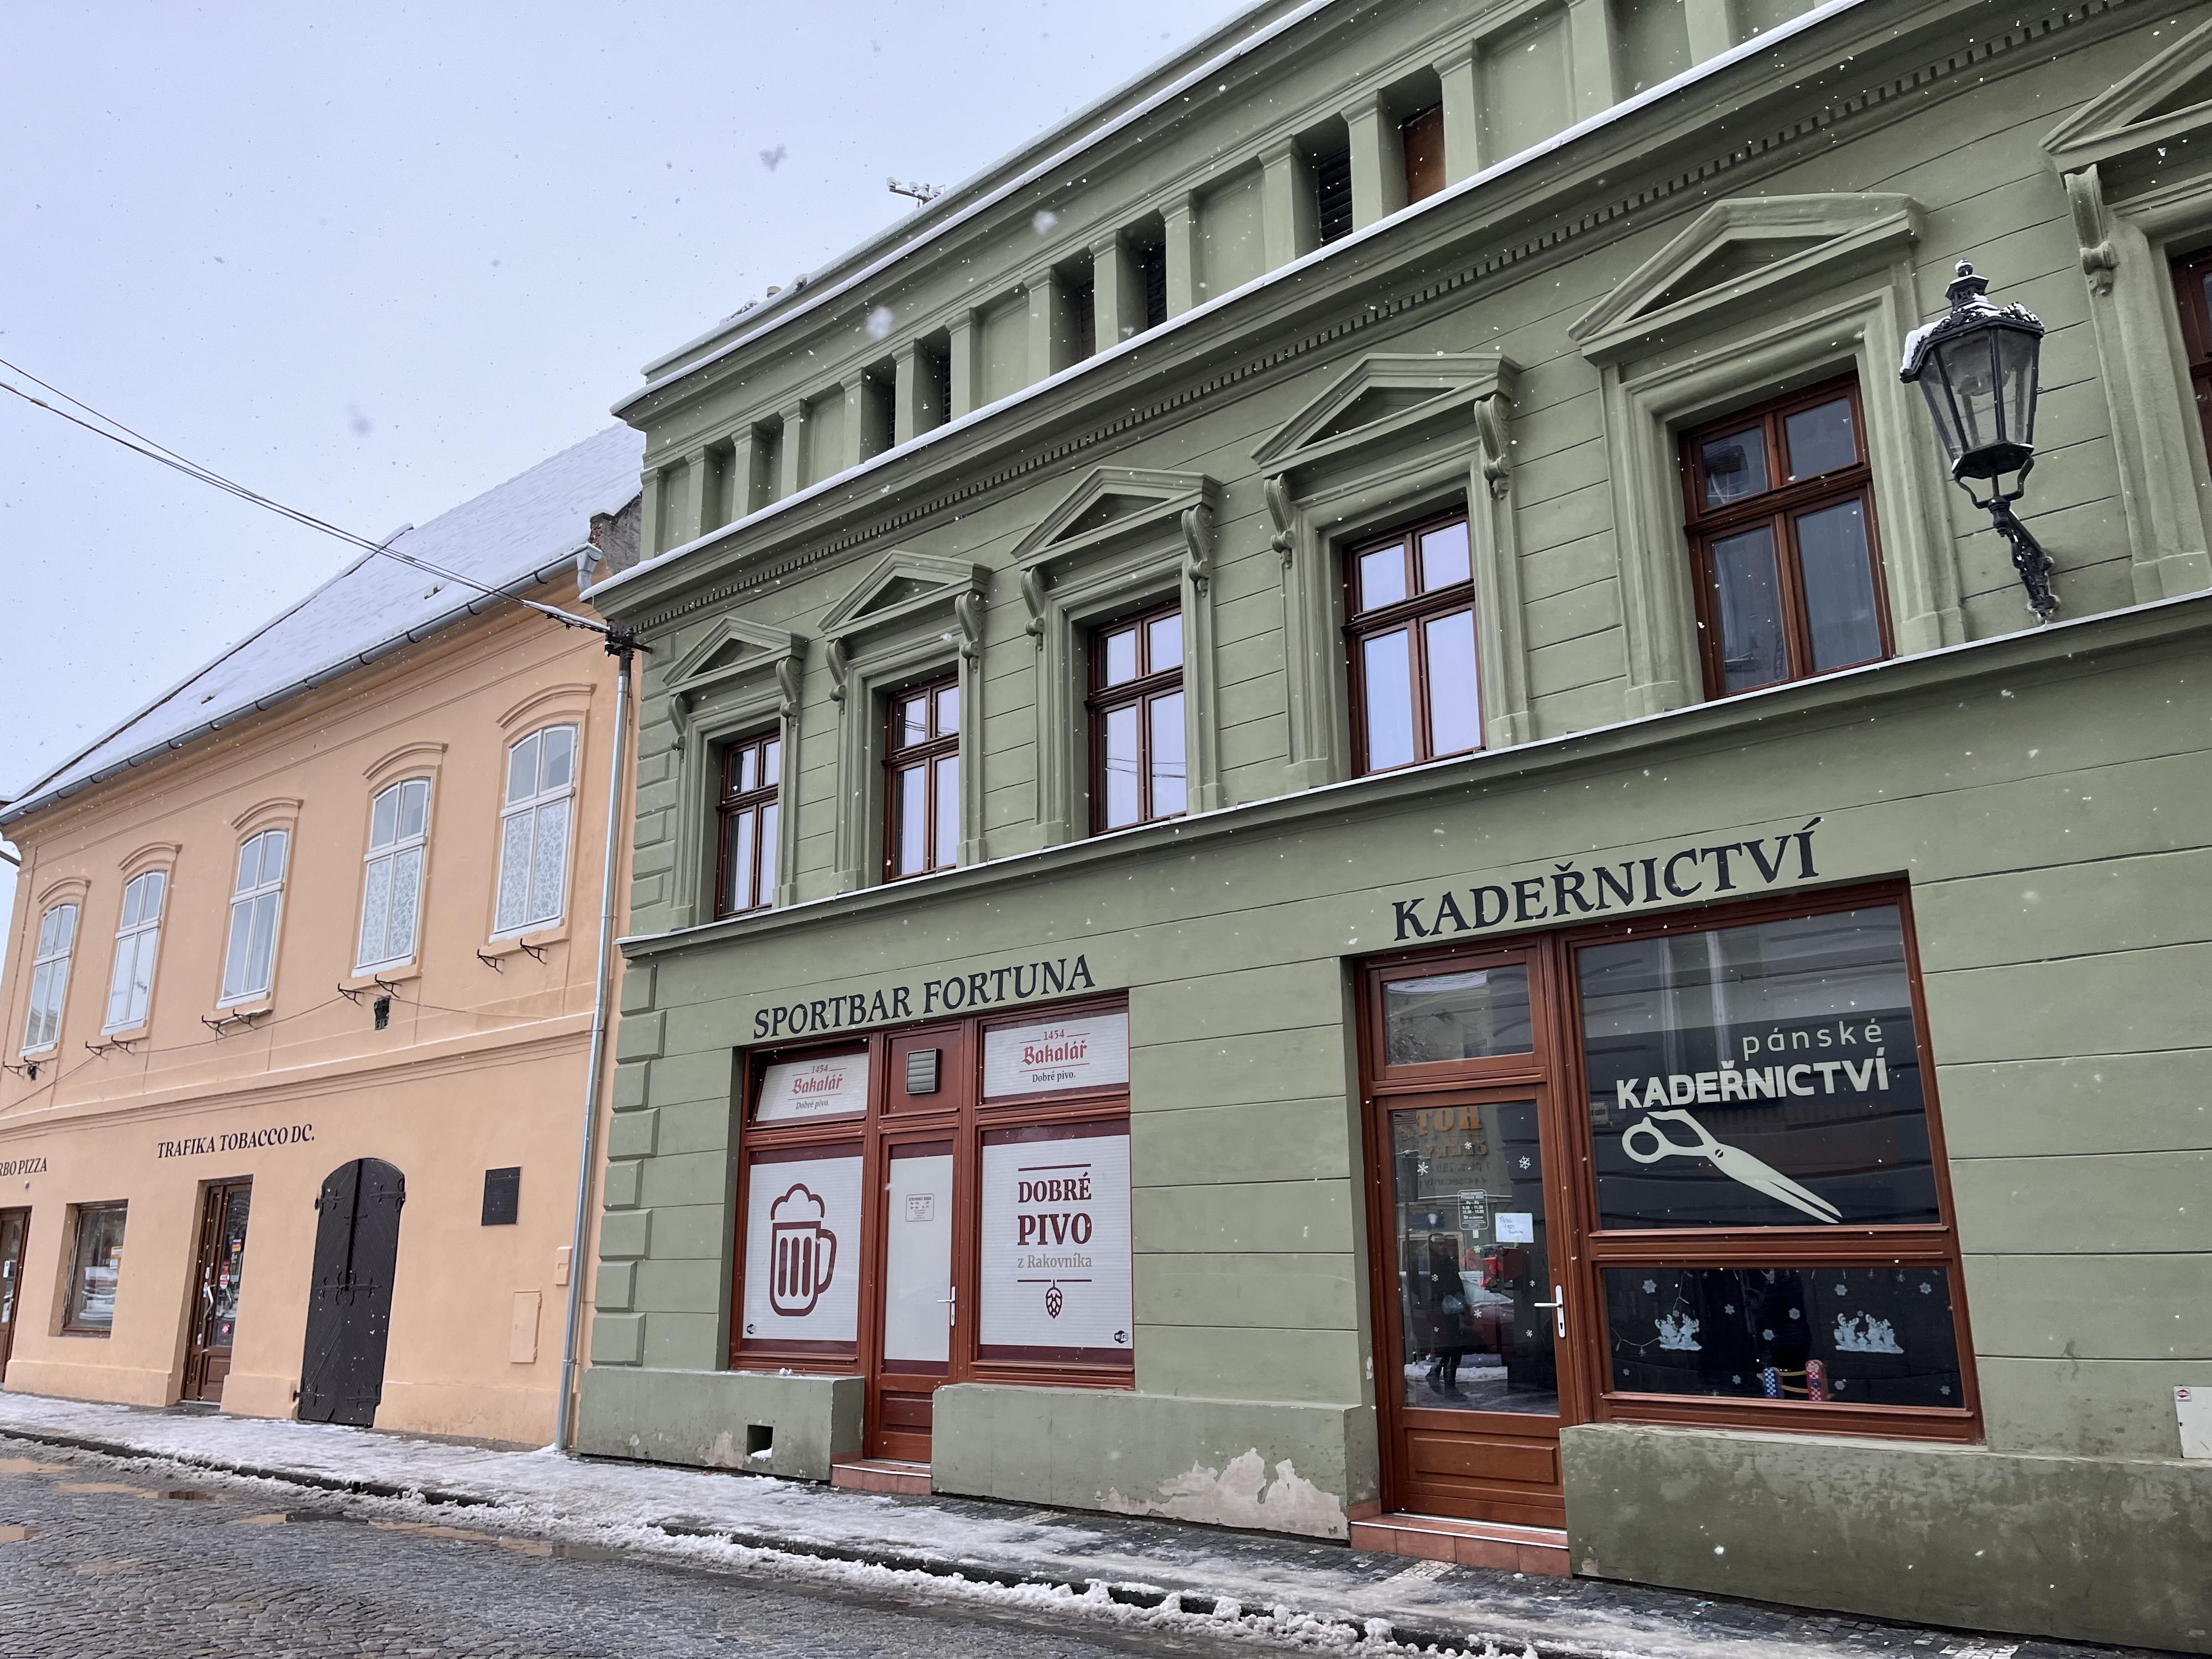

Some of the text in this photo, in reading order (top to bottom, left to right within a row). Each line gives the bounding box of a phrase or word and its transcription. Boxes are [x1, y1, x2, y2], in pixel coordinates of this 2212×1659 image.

[1392, 816, 1820, 941] KADEŘNICTVÍ
[753, 954, 1096, 1040] SPORTBAR FORTUNA
[1044, 1029, 1065, 1040] 1454
[1743, 1019, 1883, 1060] pánské
[1022, 1040, 1087, 1065] Bakalář
[811, 1064, 828, 1074] 1454
[1032, 1070, 1076, 1082] Dobré pivo.
[1616, 1047, 1890, 1110] KADEŘNICTVÍ
[791, 1073, 843, 1094] Bakalář
[796, 1099, 830, 1110] Dobré pivo.
[158, 1123, 315, 1159] TRAFIKA TOBACCO DC.
[18, 1157, 47, 1175] PIZZA
[1018, 1172, 1092, 1203] DOBRÉ
[1018, 1213, 1092, 1245] PIVO
[1018, 1253, 1092, 1269] z Rakovníka
